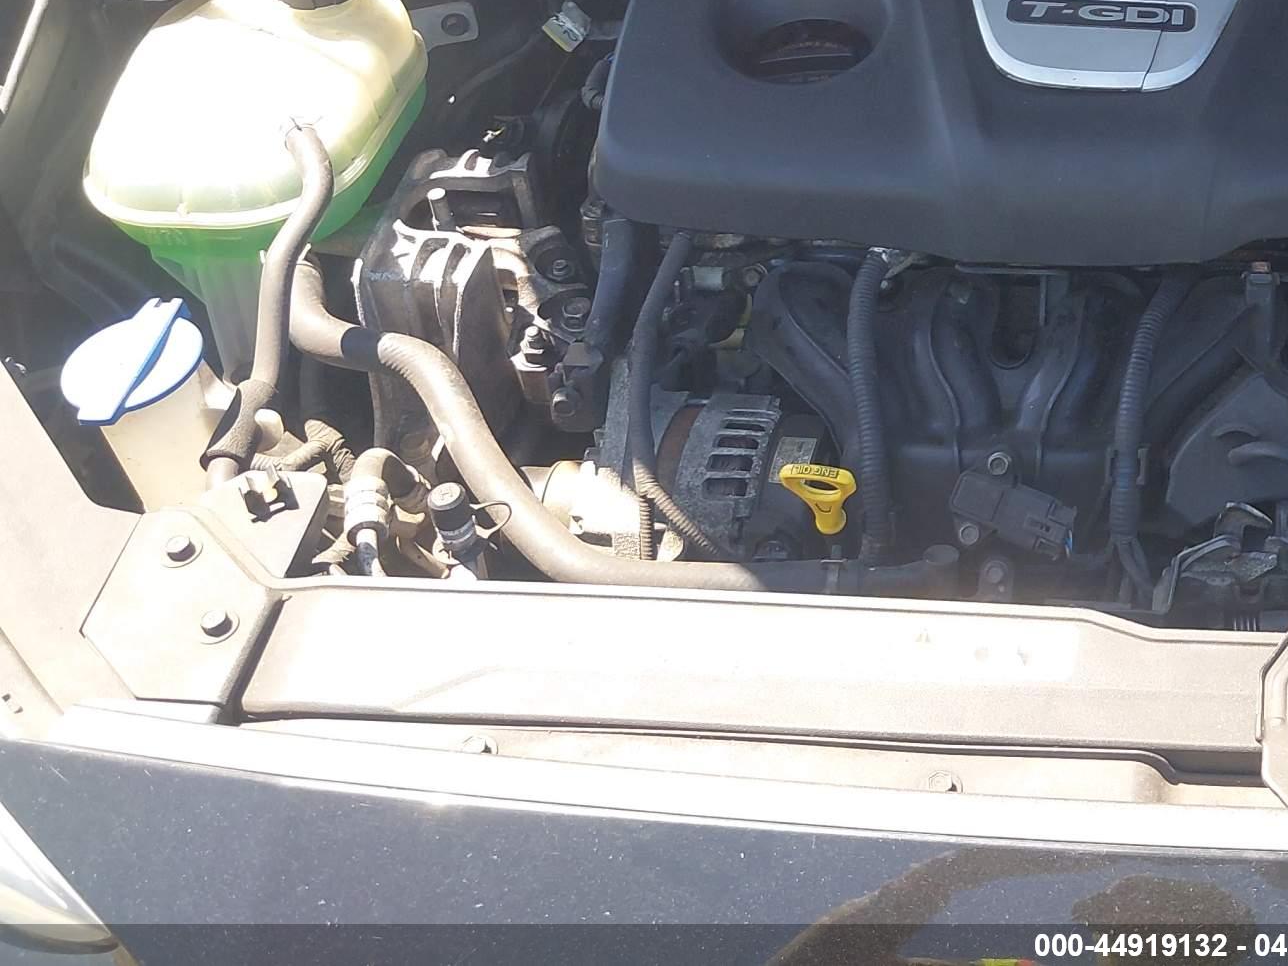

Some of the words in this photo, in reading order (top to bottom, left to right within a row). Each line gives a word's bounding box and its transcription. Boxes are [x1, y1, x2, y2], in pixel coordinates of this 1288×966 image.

[1021, 1, 1185, 26] T-GDI
[793, 465, 811, 474] OIL
[812, 467, 838, 478] ENG
